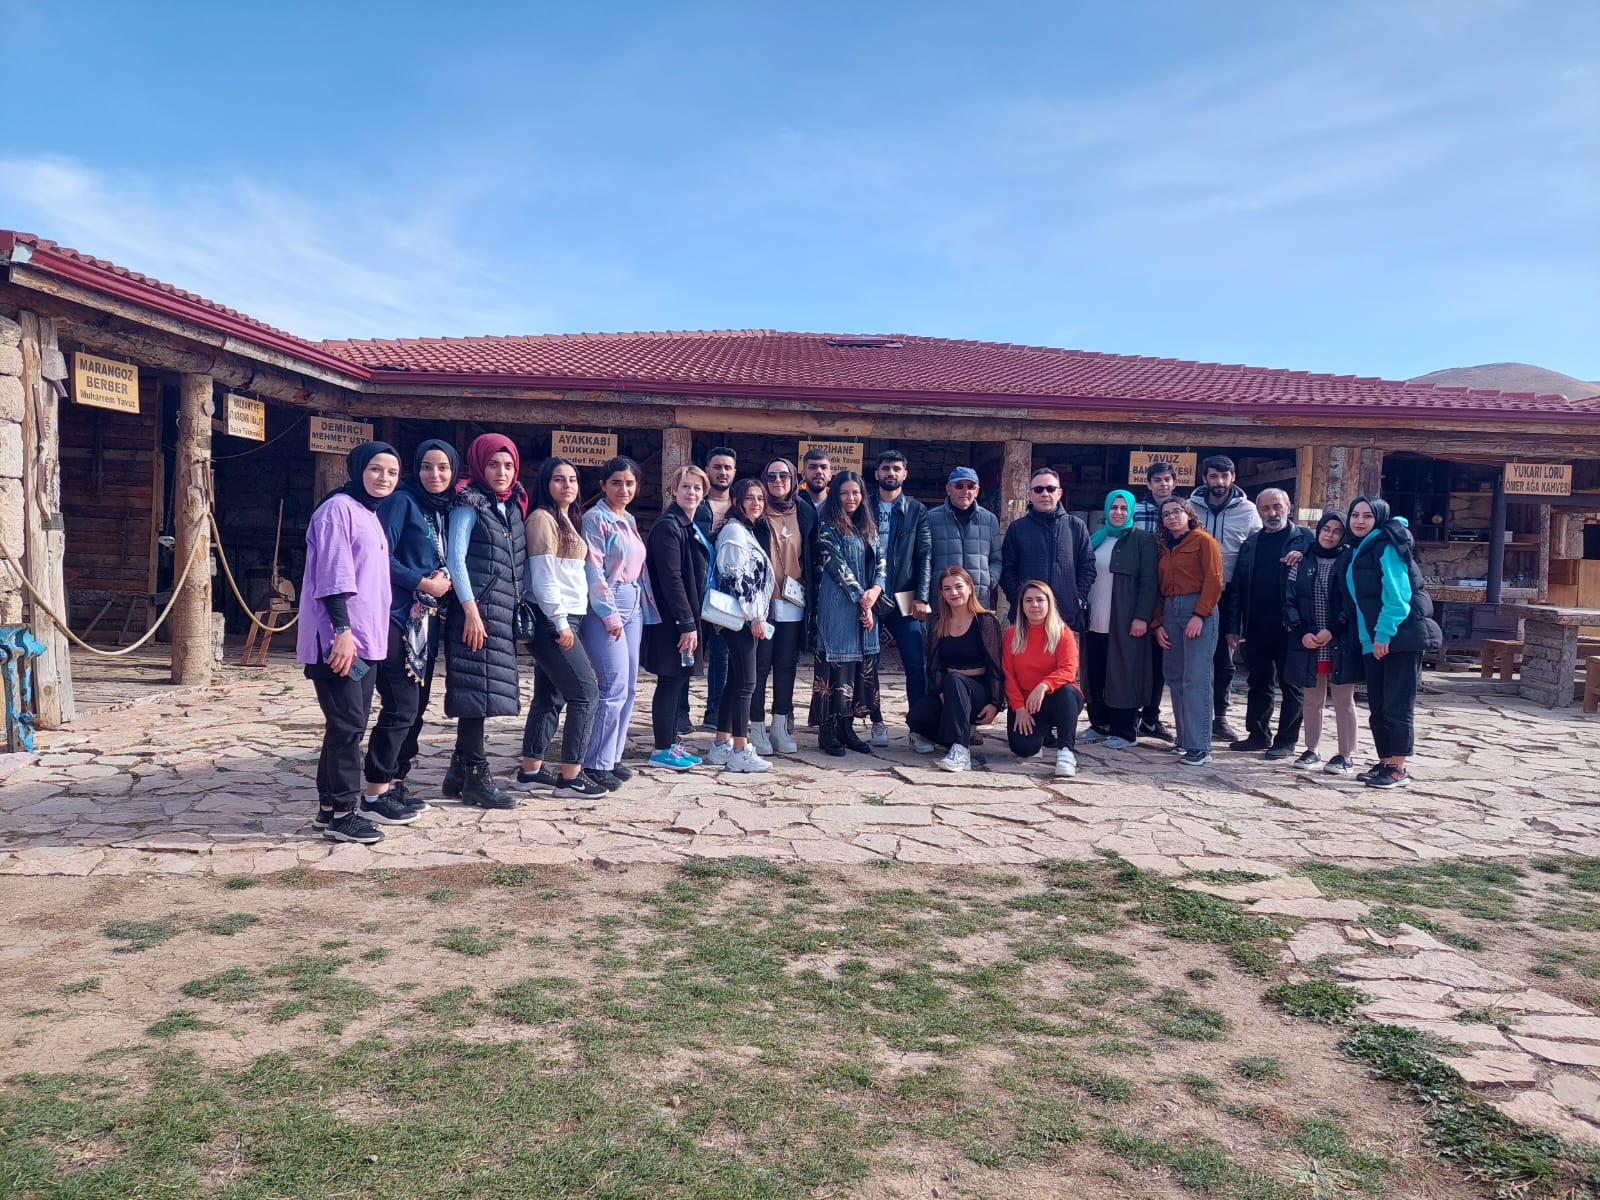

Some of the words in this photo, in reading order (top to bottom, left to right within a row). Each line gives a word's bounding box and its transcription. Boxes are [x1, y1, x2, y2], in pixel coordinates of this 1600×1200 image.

[80, 358, 133, 382] MARANGOZ
[86, 375, 128, 395] BERBER
[80, 389, 115, 404] Muharrem
[116, 395, 136, 408] Yavuz
[321, 421, 363, 435] DEMİRCİ
[312, 431, 347, 443] MEHMET
[558, 434, 611, 446] AYAKKABI
[1147, 453, 1180, 464] YAVUZ
[1513, 465, 1542, 479] YUKARI
[1543, 465, 1565, 480] LORU
[1505, 478, 1525, 492] ÖMER
[1525, 479, 1540, 493] AĞA
